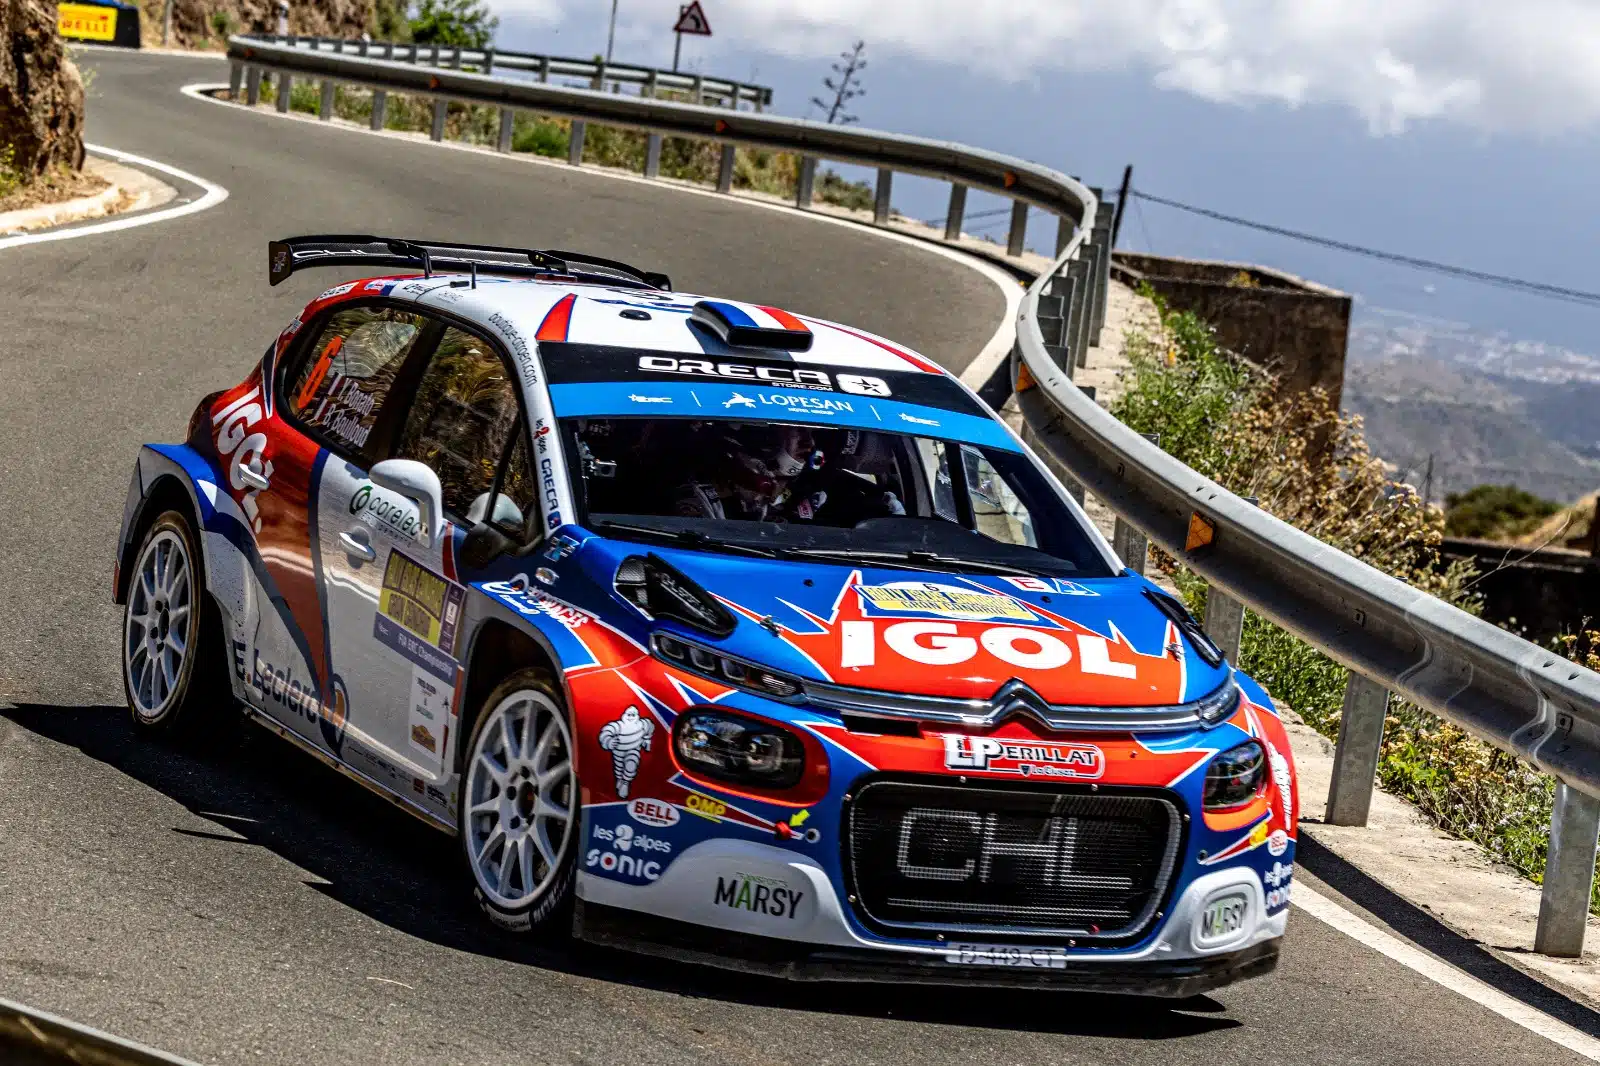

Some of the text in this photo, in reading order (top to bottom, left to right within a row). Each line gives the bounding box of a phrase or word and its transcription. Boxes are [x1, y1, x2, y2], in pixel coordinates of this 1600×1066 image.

[638, 355, 833, 385] ORECA
[758, 393, 854, 413] LOPESAN
[540, 458, 559, 511] ORECA
[841, 621, 1137, 680] IGOL
[634, 801, 675, 820] BELL
[686, 794, 726, 816] OMP
[592, 824, 672, 853] les 2 alpes
[897, 807, 1133, 890] CHL
[713, 876, 804, 919] MARSY
